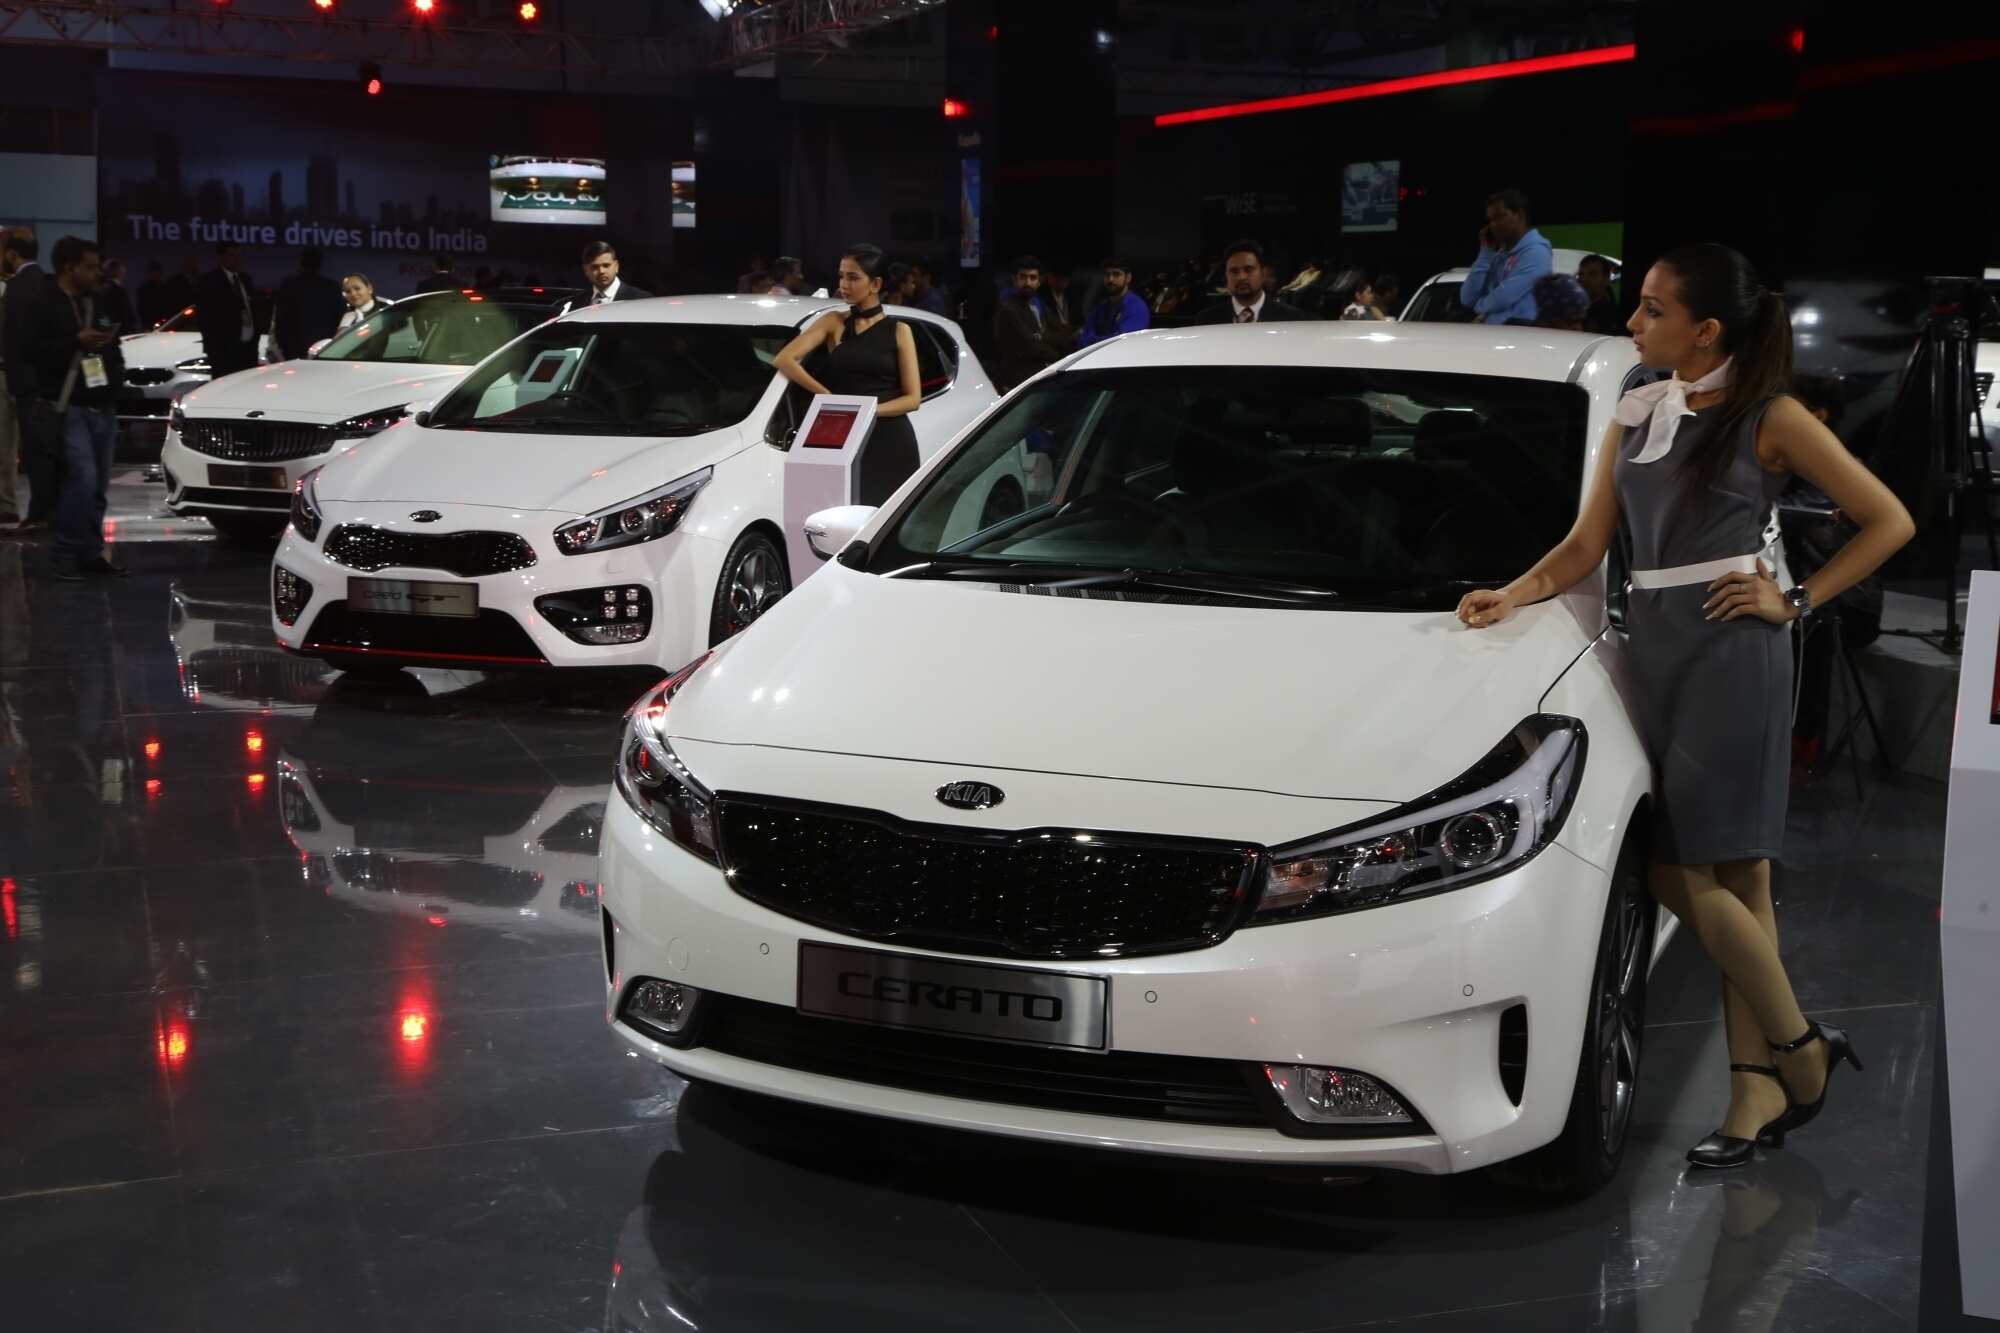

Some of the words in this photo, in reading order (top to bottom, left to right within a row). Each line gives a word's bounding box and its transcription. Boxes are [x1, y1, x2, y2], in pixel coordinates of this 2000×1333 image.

[127, 213, 181, 241] The
[190, 216, 276, 245] future
[284, 221, 363, 248] drives
[371, 224, 421, 250] into
[428, 226, 487, 252] India
[944, 784, 991, 804] KIA
[838, 971, 1063, 1021] CERATO
